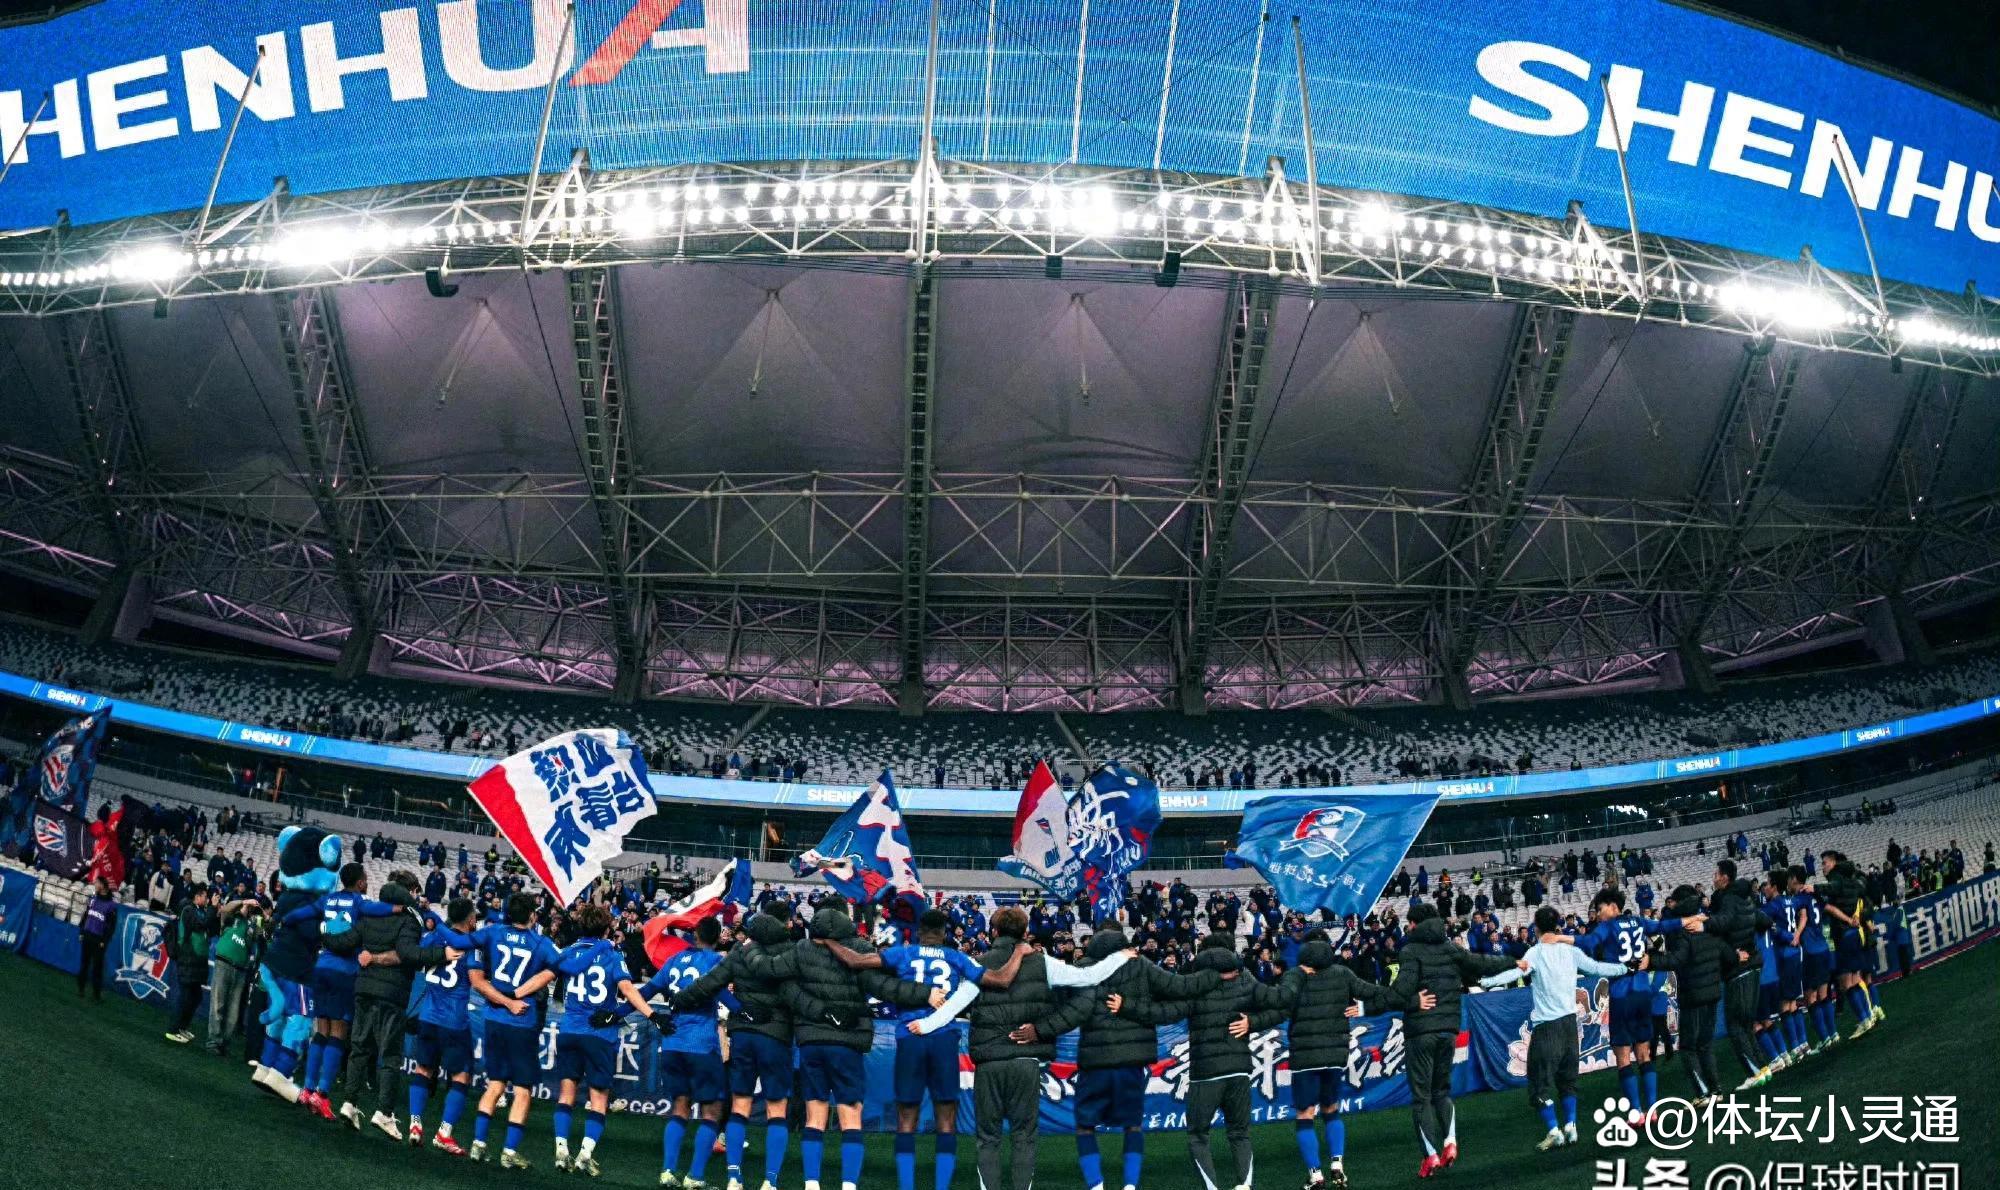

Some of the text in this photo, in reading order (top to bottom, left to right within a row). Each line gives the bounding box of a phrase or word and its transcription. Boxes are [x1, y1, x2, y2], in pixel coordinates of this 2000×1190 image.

[808, 788, 862, 803] SHENH
[1159, 794, 1209, 809] ENHUA
[1618, 926, 1646, 963] 33
[494, 944, 532, 987] 27
[910, 959, 952, 995] 13
[566, 965, 608, 1005] 43
